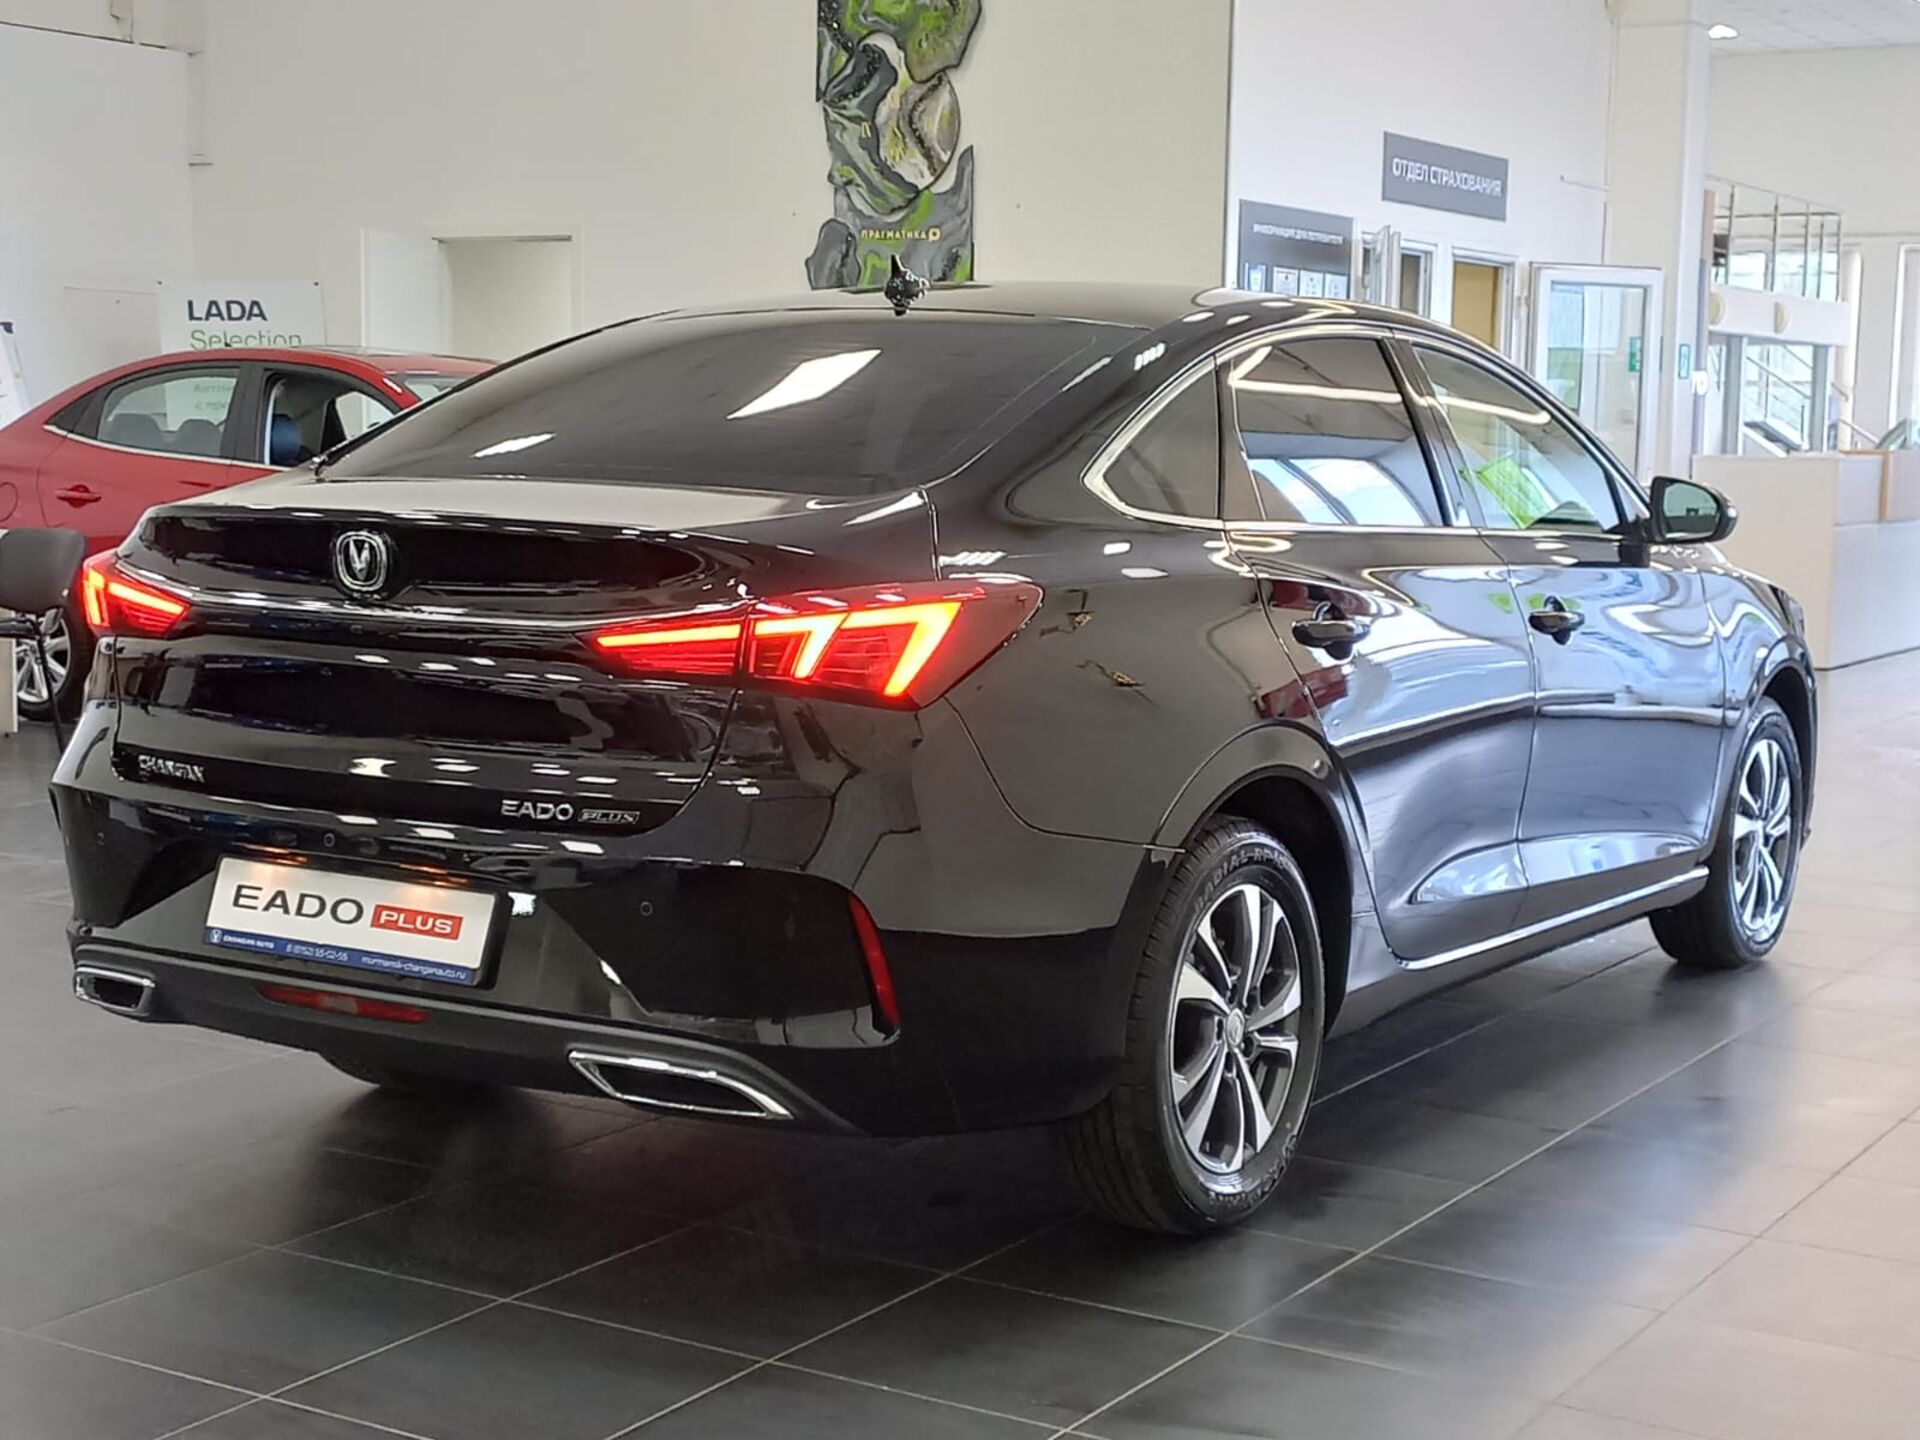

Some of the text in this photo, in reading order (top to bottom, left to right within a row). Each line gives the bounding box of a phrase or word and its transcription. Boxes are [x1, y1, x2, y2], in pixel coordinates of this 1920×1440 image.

[1392, 157, 1502, 198] ОТДЕЛ СТРАХОВАНИЯ
[861, 229, 927, 240] ПРАГМАТИКА
[187, 299, 268, 322] LADA
[190, 329, 302, 350] Selection
[500, 799, 638, 823] EADO PLUS
[232, 884, 454, 934] EADO PLUS
